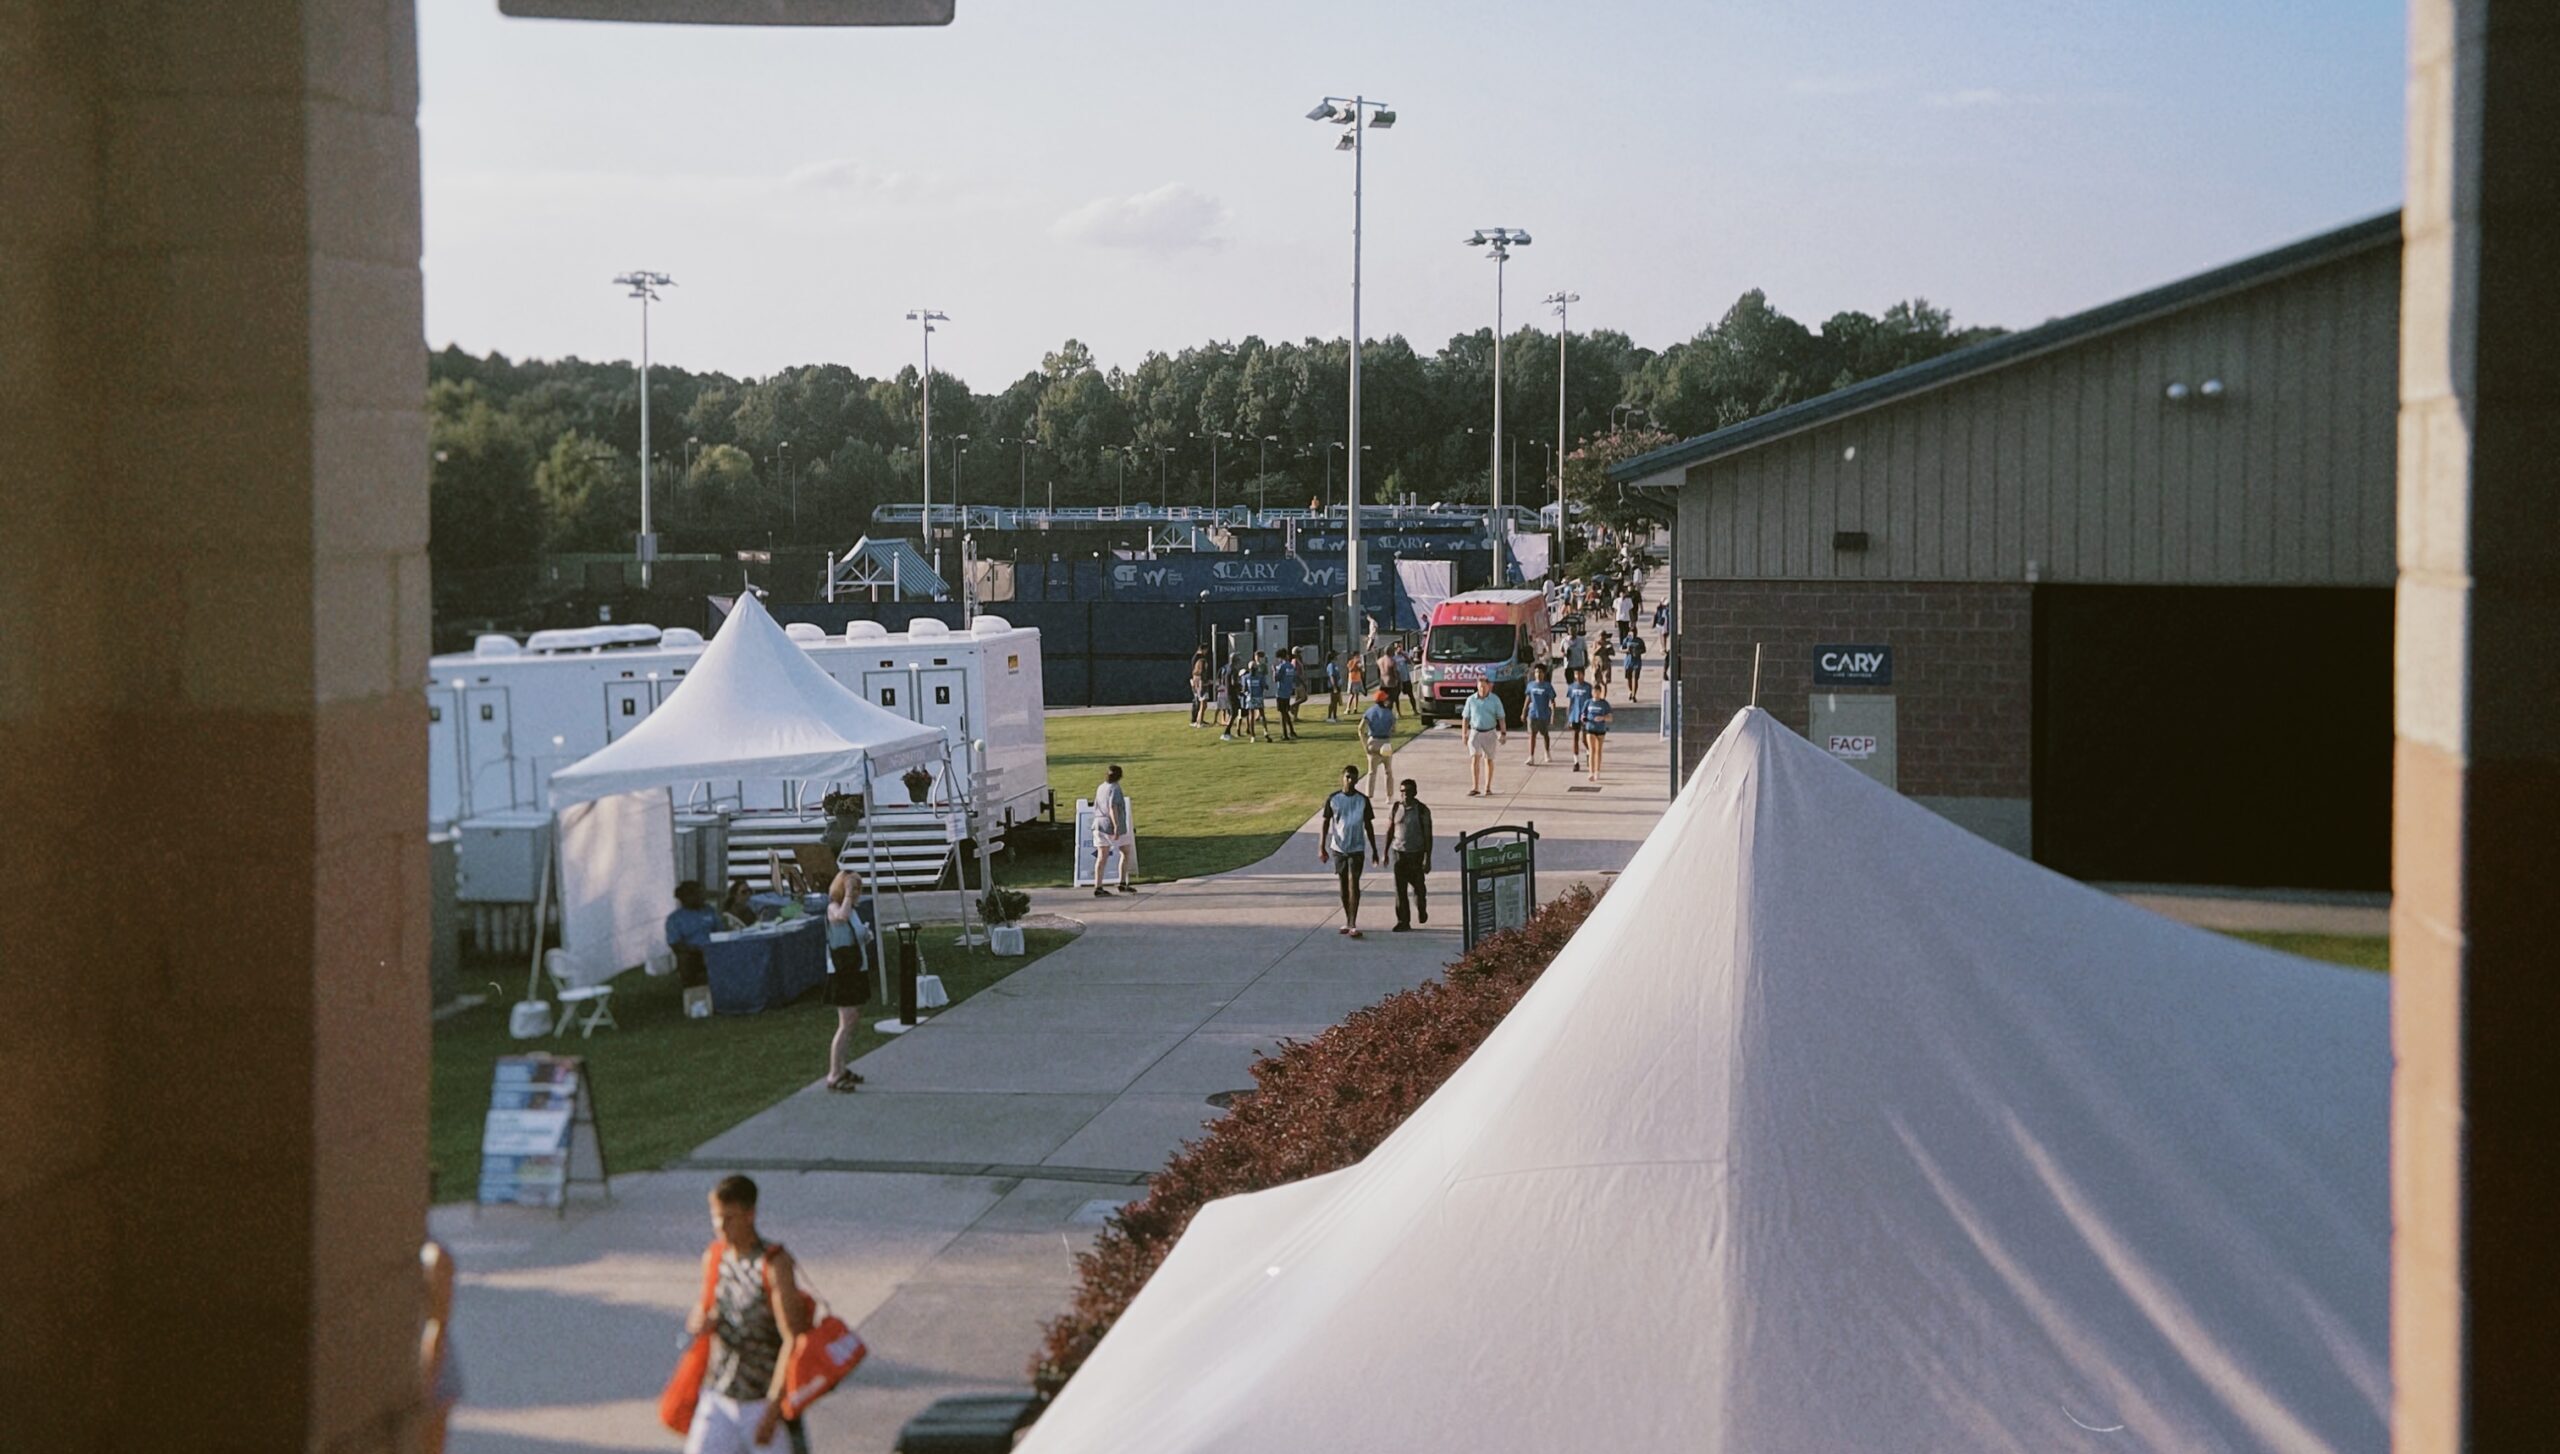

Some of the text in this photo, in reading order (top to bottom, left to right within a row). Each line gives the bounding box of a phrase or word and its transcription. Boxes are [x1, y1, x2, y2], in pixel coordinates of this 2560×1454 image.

[1224, 561, 1280, 579] CARY
[1214, 584, 1280, 593] TENNIS CLASSIC
[1821, 652, 1884, 672] CARY
[1444, 664, 1487, 674] KING
[1830, 738, 1874, 751] FACP
